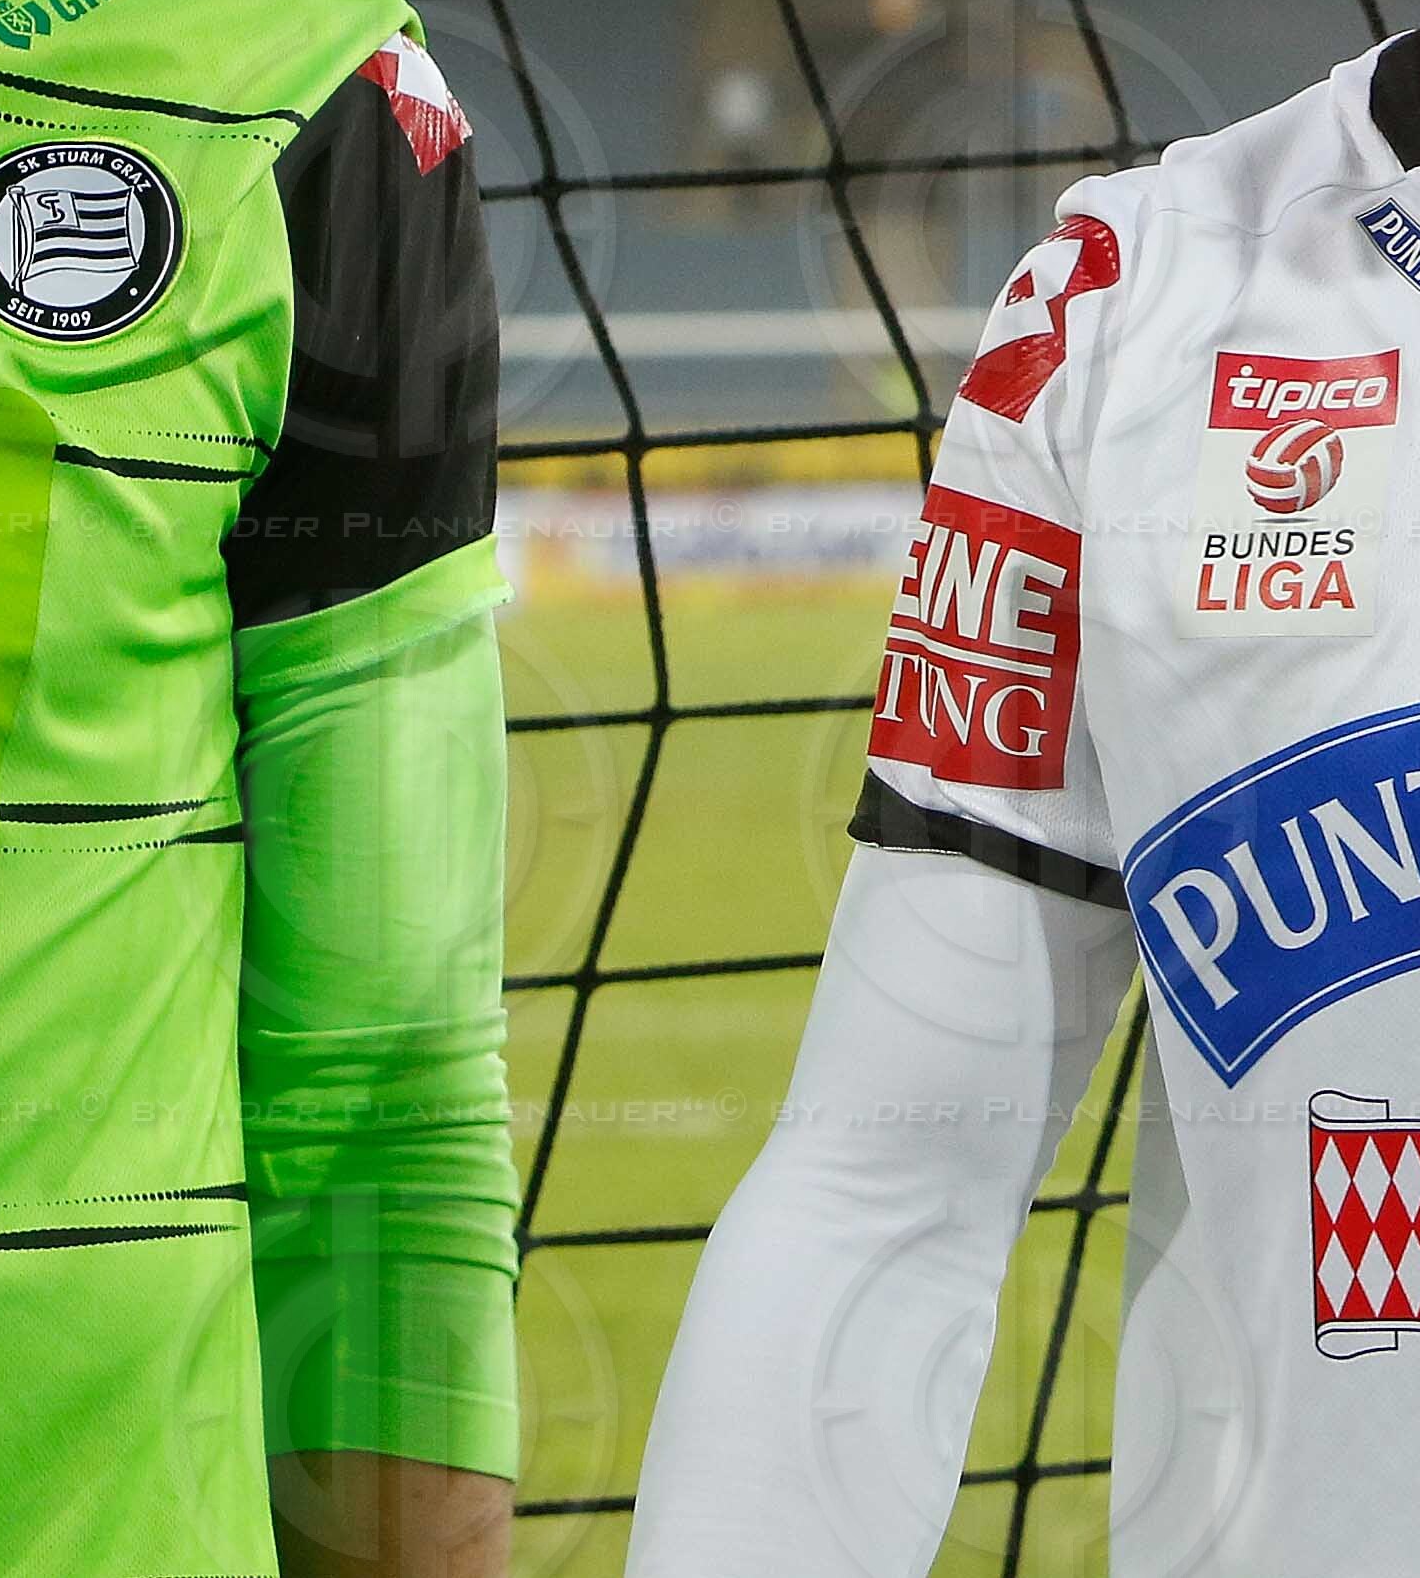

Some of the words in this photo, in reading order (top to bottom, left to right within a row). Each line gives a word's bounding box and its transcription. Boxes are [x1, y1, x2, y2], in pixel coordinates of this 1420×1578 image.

[17, 158, 40, 174] SK
[46, 151, 105, 165] STURM
[111, 158, 152, 192] GRAZ
[7, 298, 44, 323] SEIT
[52, 311, 91, 327] 1909
[1227, 365, 1389, 418] tipico
[1203, 528, 1355, 560] BUNDES
[1196, 560, 1357, 612] LIGA
